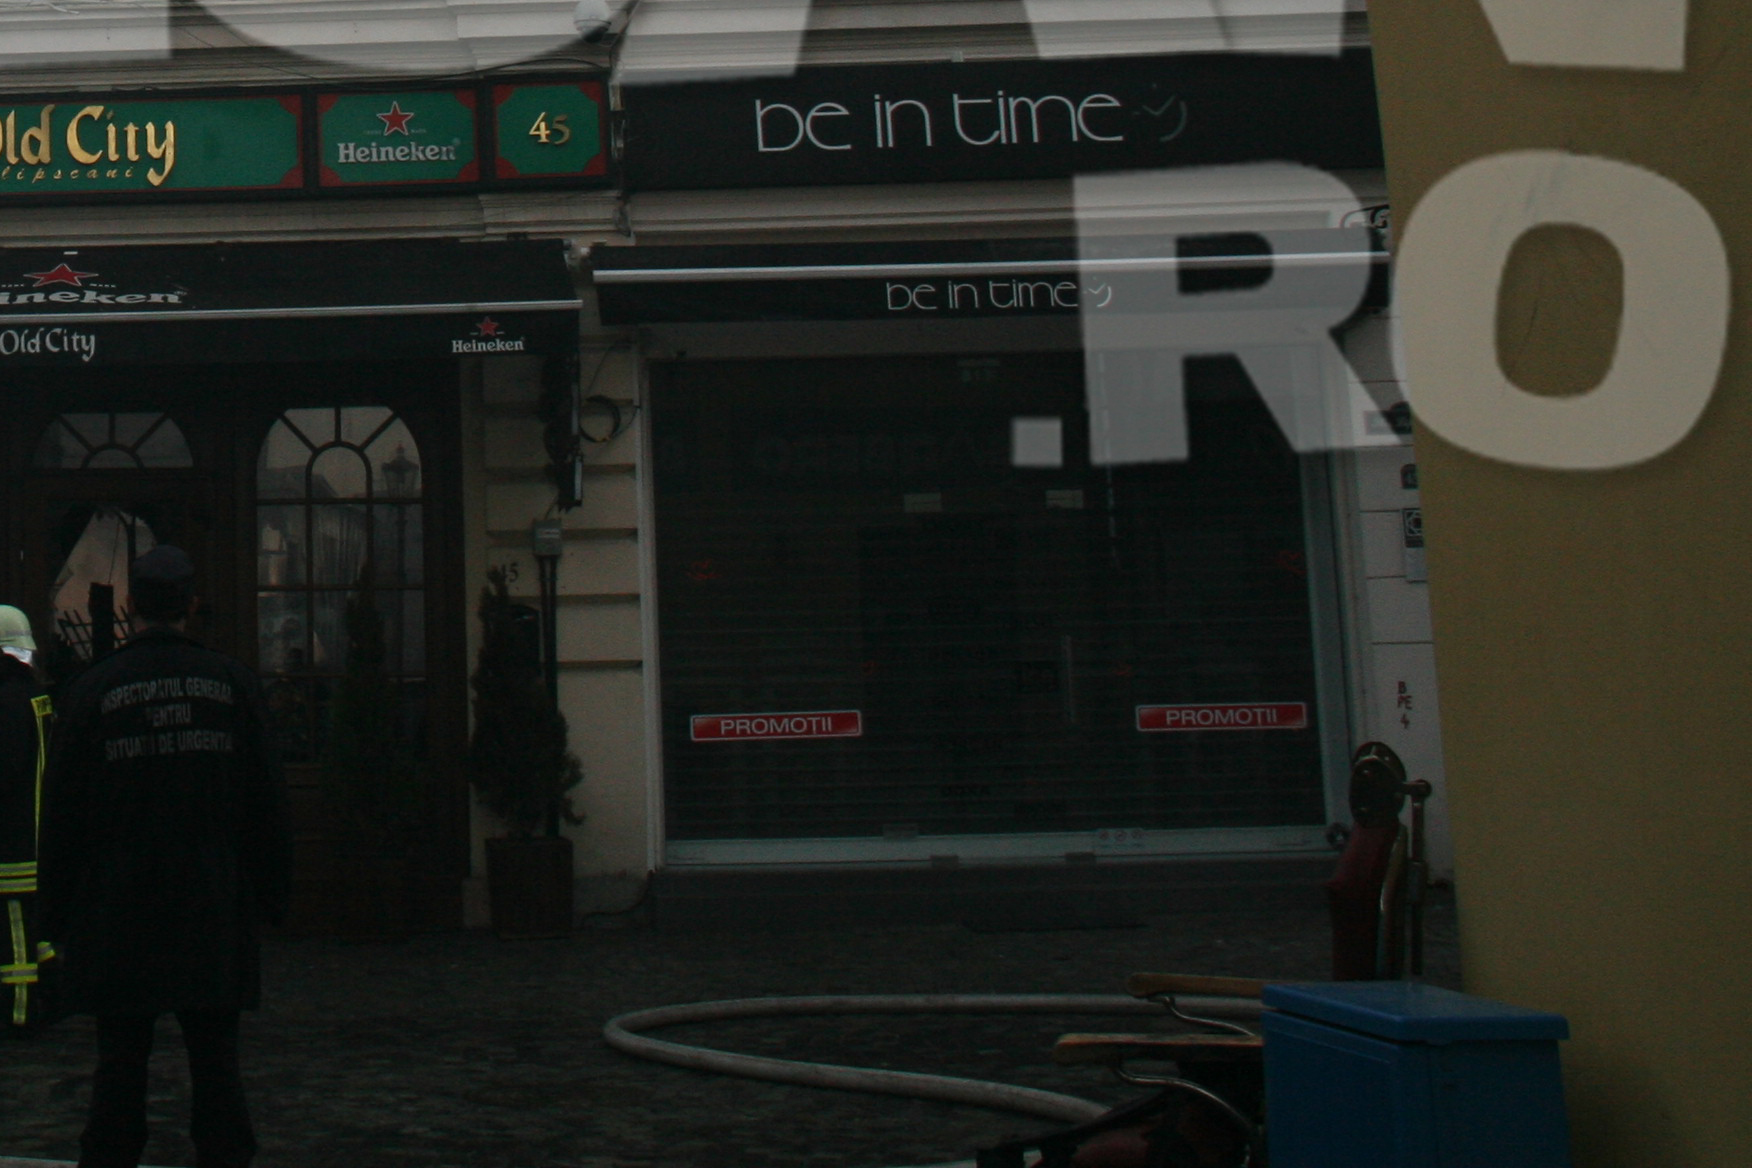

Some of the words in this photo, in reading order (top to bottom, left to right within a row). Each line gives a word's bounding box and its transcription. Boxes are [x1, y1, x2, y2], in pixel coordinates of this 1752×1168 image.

[527, 111, 572, 145] 45
[754, 98, 852, 152] be
[873, 93, 933, 148] in
[952, 90, 1124, 146] time
[66, 105, 175, 186] City
[336, 141, 457, 164] Heineken
[0, 165, 134, 183] lipscani
[885, 282, 939, 311] be
[948, 280, 981, 310] in
[988, 278, 1079, 309] time
[44, 327, 96, 363] City
[451, 338, 525, 353] Heineken
